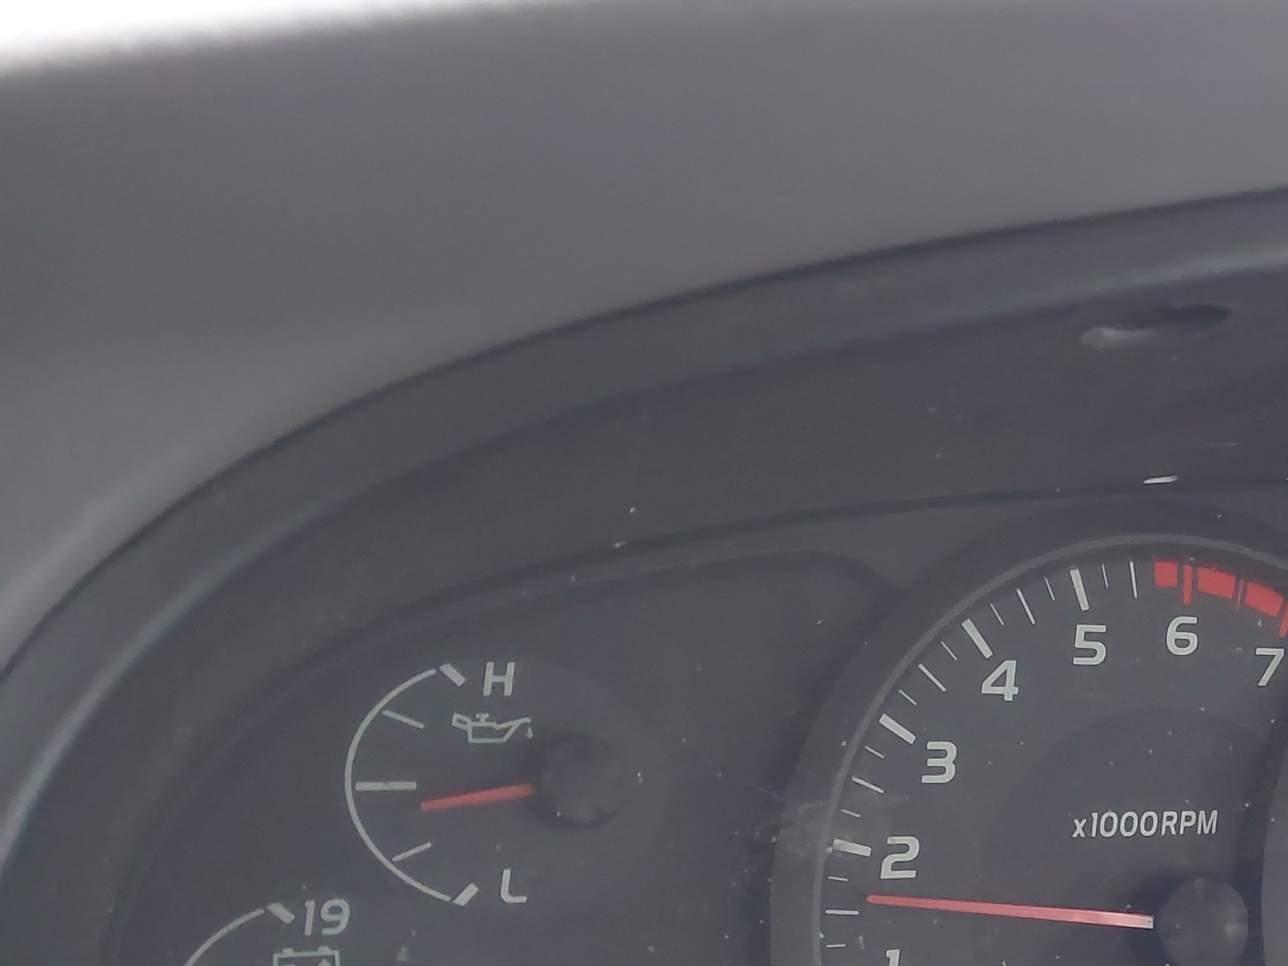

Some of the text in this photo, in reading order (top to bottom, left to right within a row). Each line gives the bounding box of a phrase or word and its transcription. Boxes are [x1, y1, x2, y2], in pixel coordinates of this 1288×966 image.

[1073, 625, 1106, 664] 5
[1167, 617, 1197, 655] 6
[483, 662, 515, 696] H
[982, 660, 1018, 701] 4
[1256, 648, 1284, 685] 7
[922, 742, 956, 783] 3
[881, 837, 919, 878] 2
[501, 869, 527, 903] L
[305, 899, 350, 936] 19
